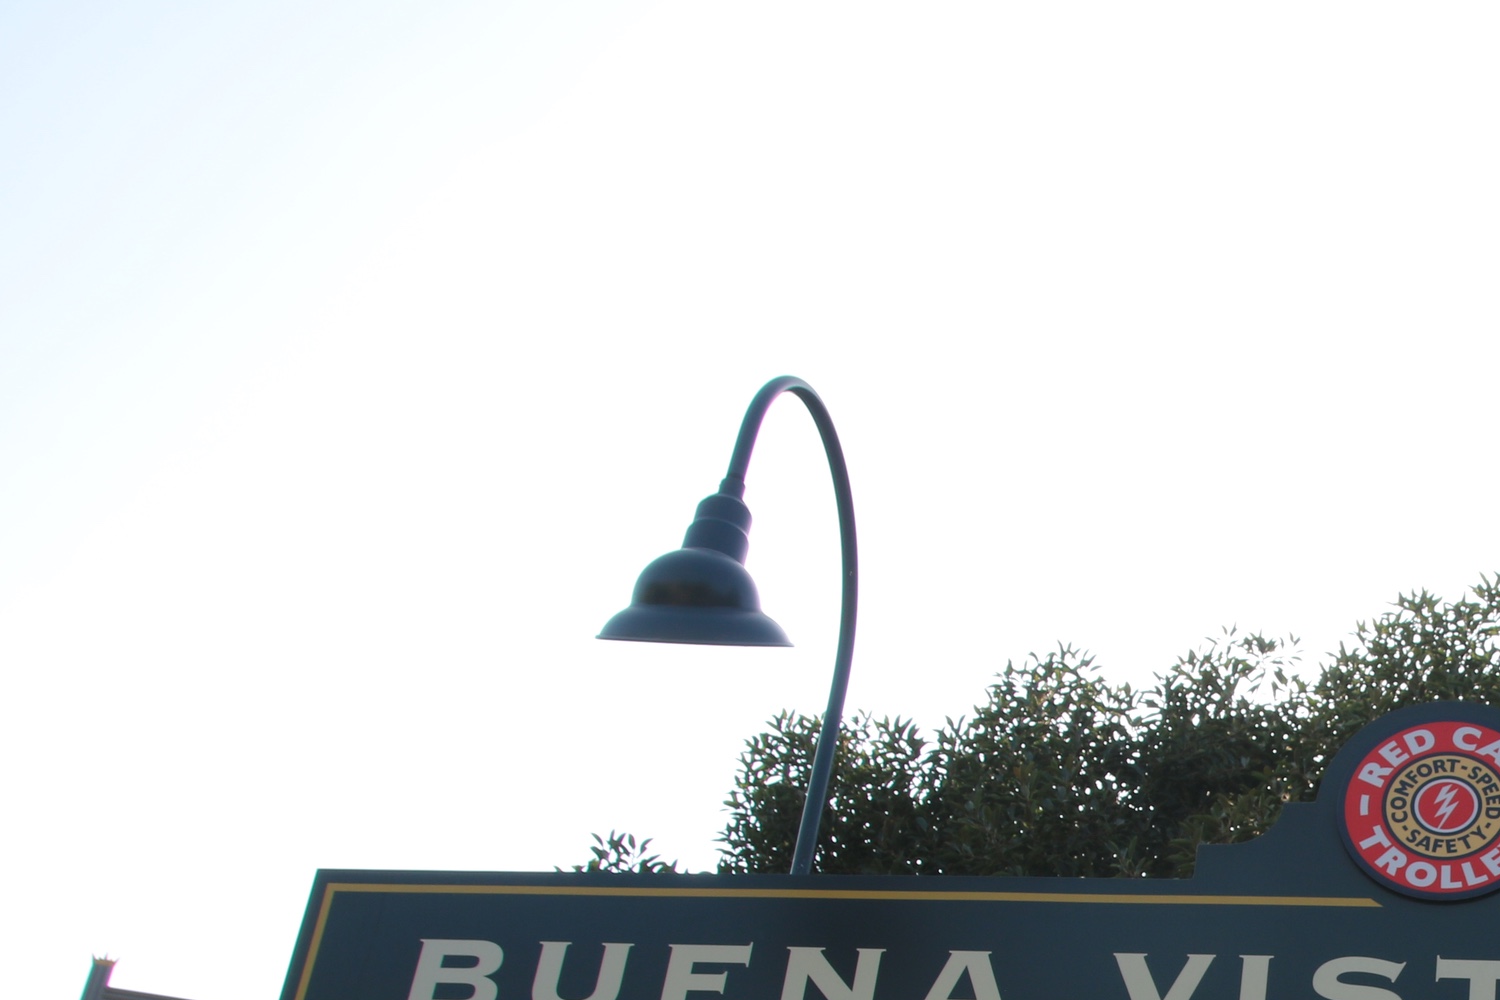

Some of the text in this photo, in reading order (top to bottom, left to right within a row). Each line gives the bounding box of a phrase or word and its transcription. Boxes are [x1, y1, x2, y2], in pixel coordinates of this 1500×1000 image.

[1358, 729, 1436, 788] RED
[1390, 759, 1461, 823] COMFORT
[1405, 825, 1487, 854] SAFETY
